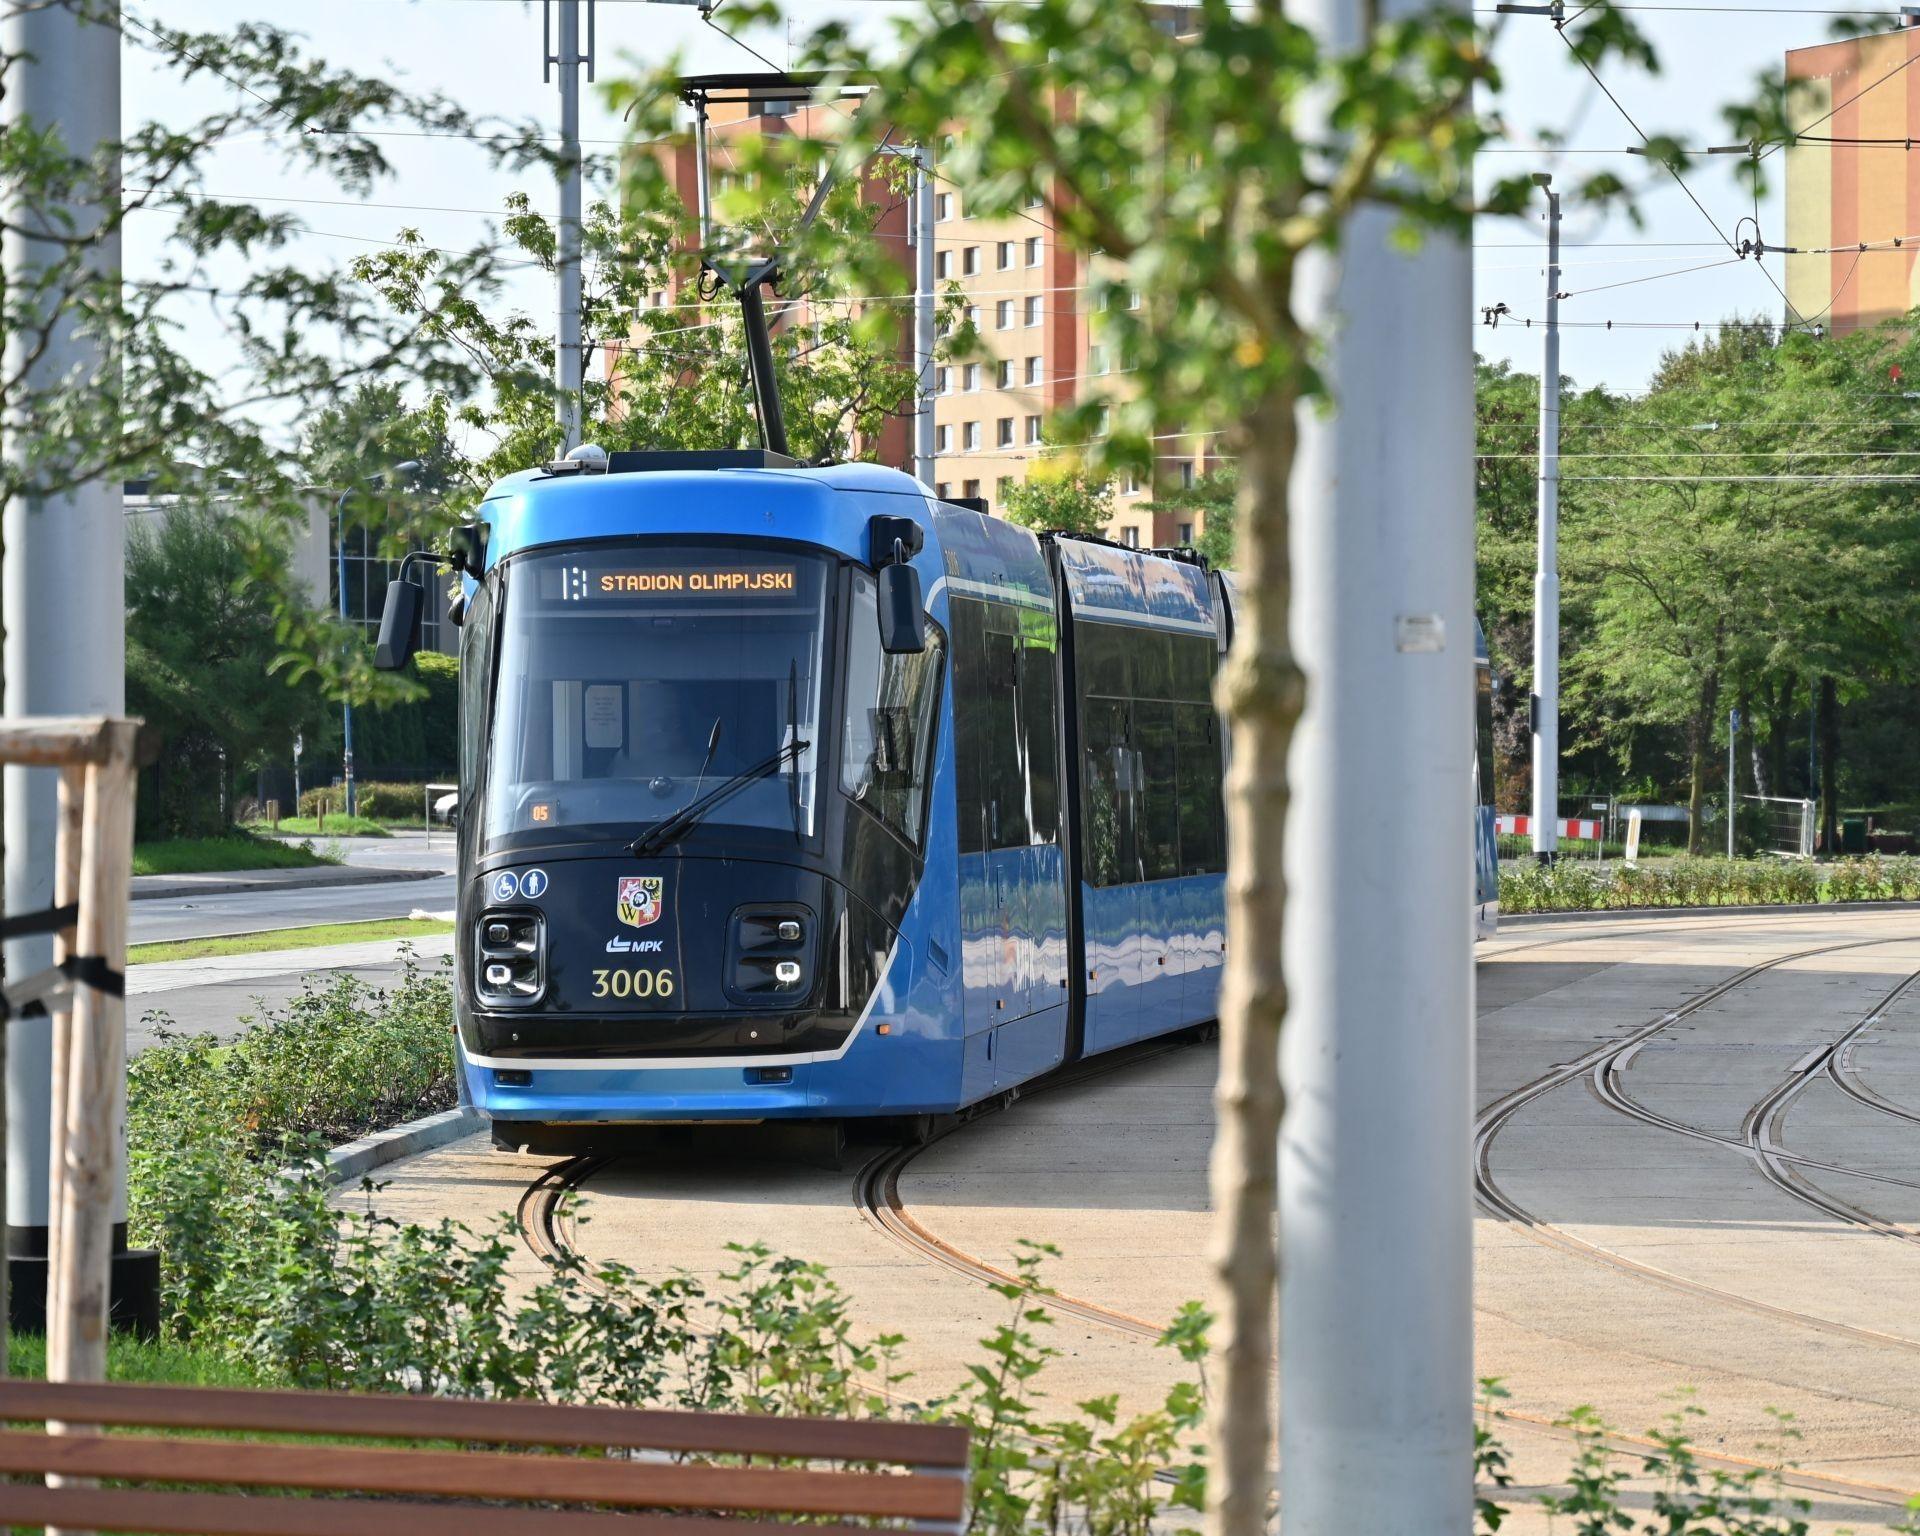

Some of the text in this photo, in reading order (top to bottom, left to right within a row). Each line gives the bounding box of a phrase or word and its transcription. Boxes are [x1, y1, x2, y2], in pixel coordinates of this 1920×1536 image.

[601, 575, 682, 591] STADION
[689, 573, 792, 590] OLIMPIJSKI
[533, 806, 548, 820] 05
[620, 903, 637, 921] W
[631, 940, 663, 952] MPK
[592, 969, 673, 997] 3006
